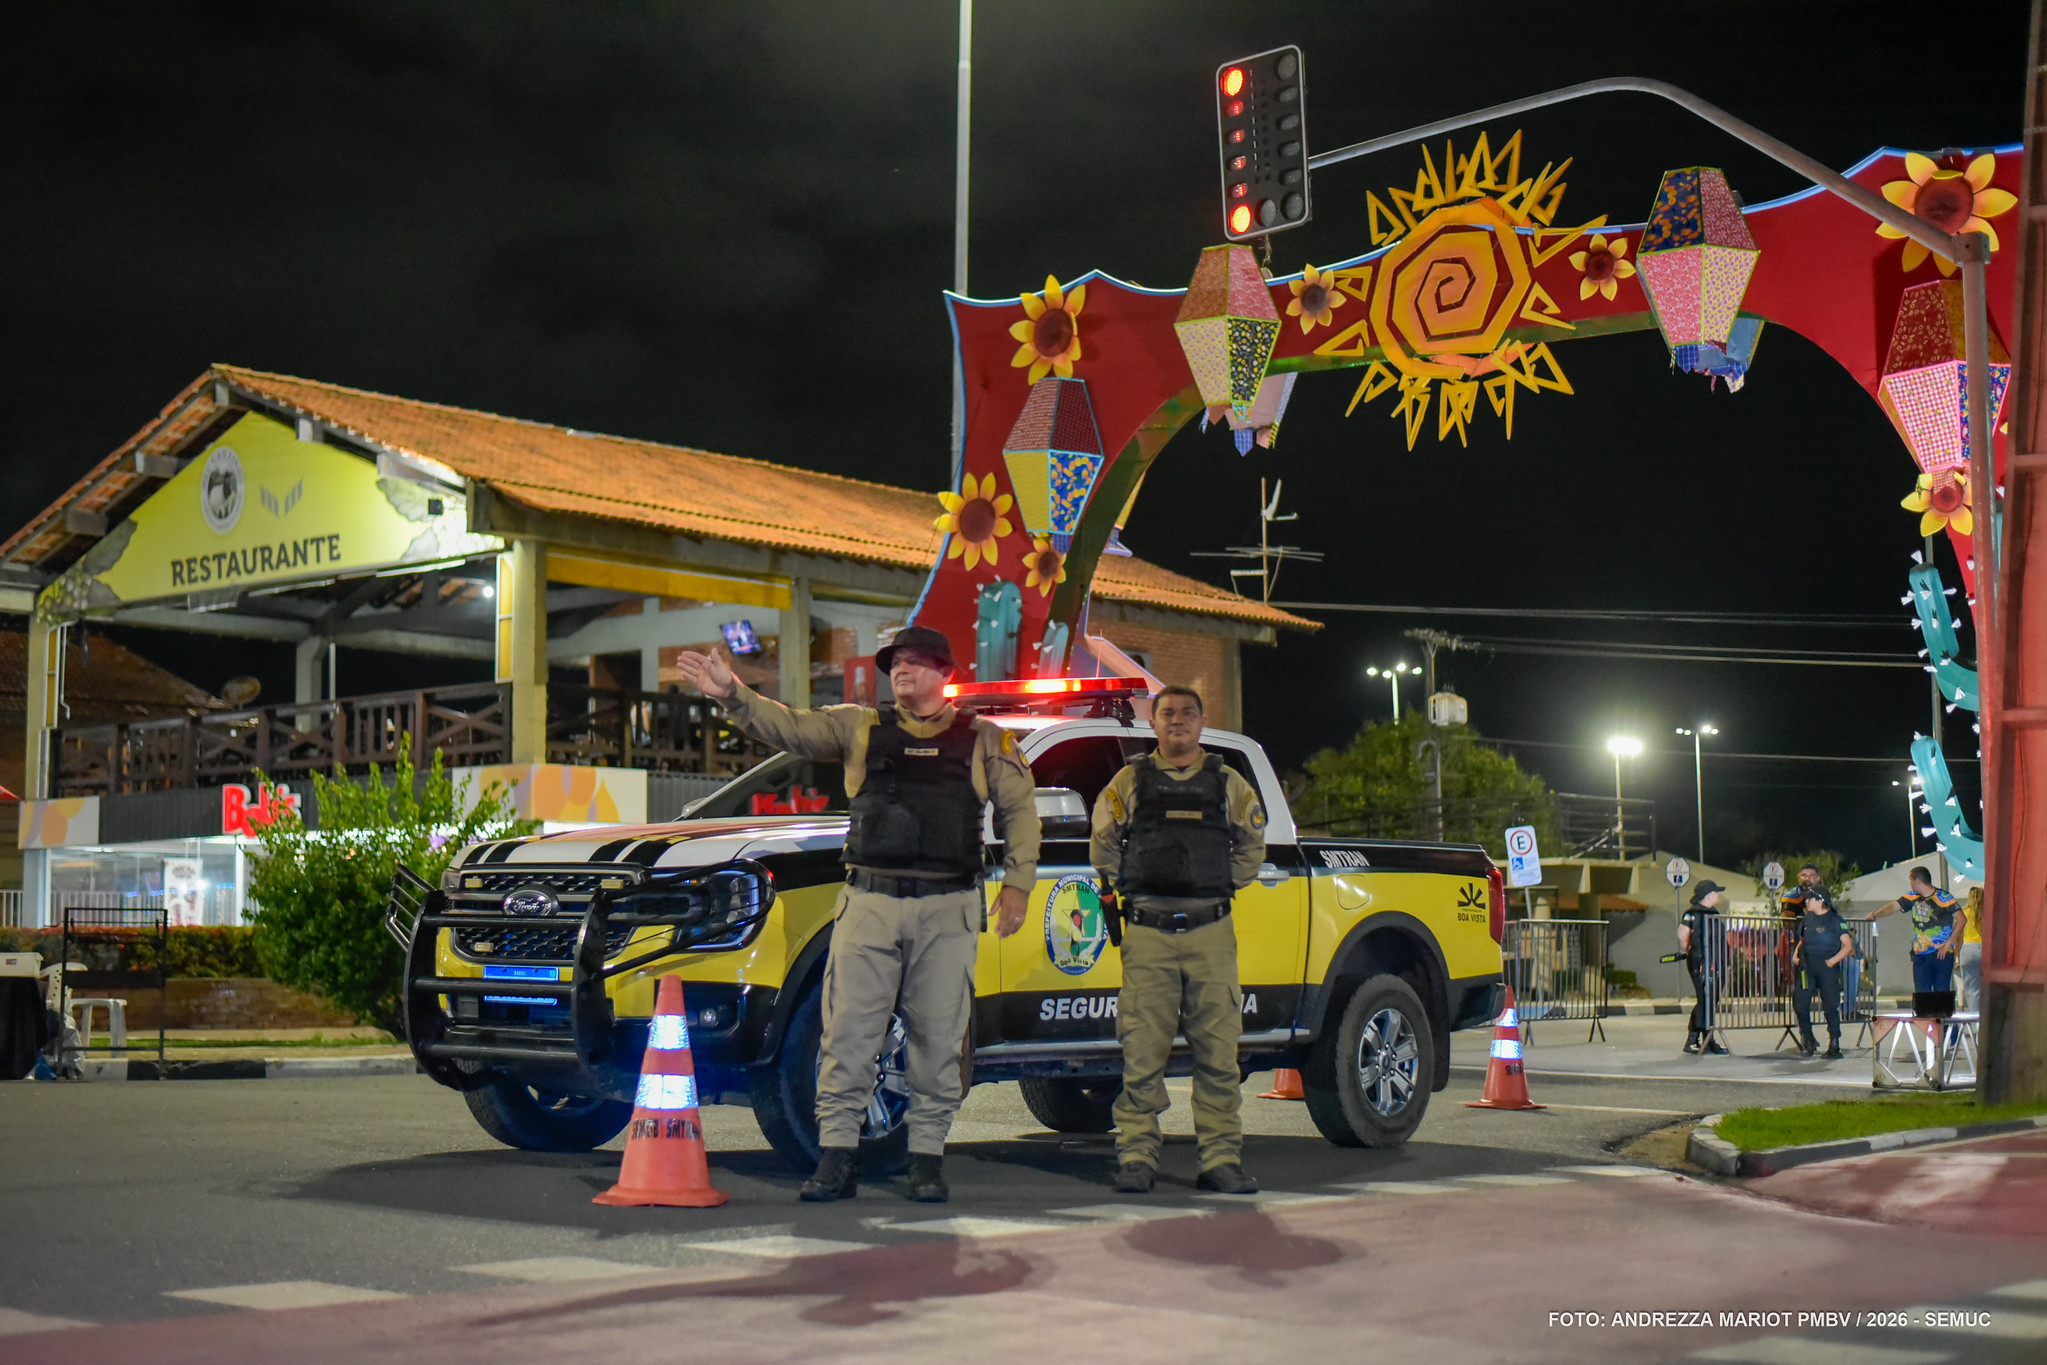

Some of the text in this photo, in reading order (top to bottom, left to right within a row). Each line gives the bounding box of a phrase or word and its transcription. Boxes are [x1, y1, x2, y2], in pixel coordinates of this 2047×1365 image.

[171, 534, 341, 586] RESTAURANTE
[1517, 835, 1526, 850] E
[1319, 850, 1370, 869] SMTRAN
[1062, 883, 1090, 895] SMTRAN
[1044, 874, 1100, 941] PREFEITURA MUNICIPAL DE
[1457, 912, 1487, 924] BOA VISTA
[1072, 955, 1089, 967] Vista
[1039, 996, 1119, 1021] SEGUR
